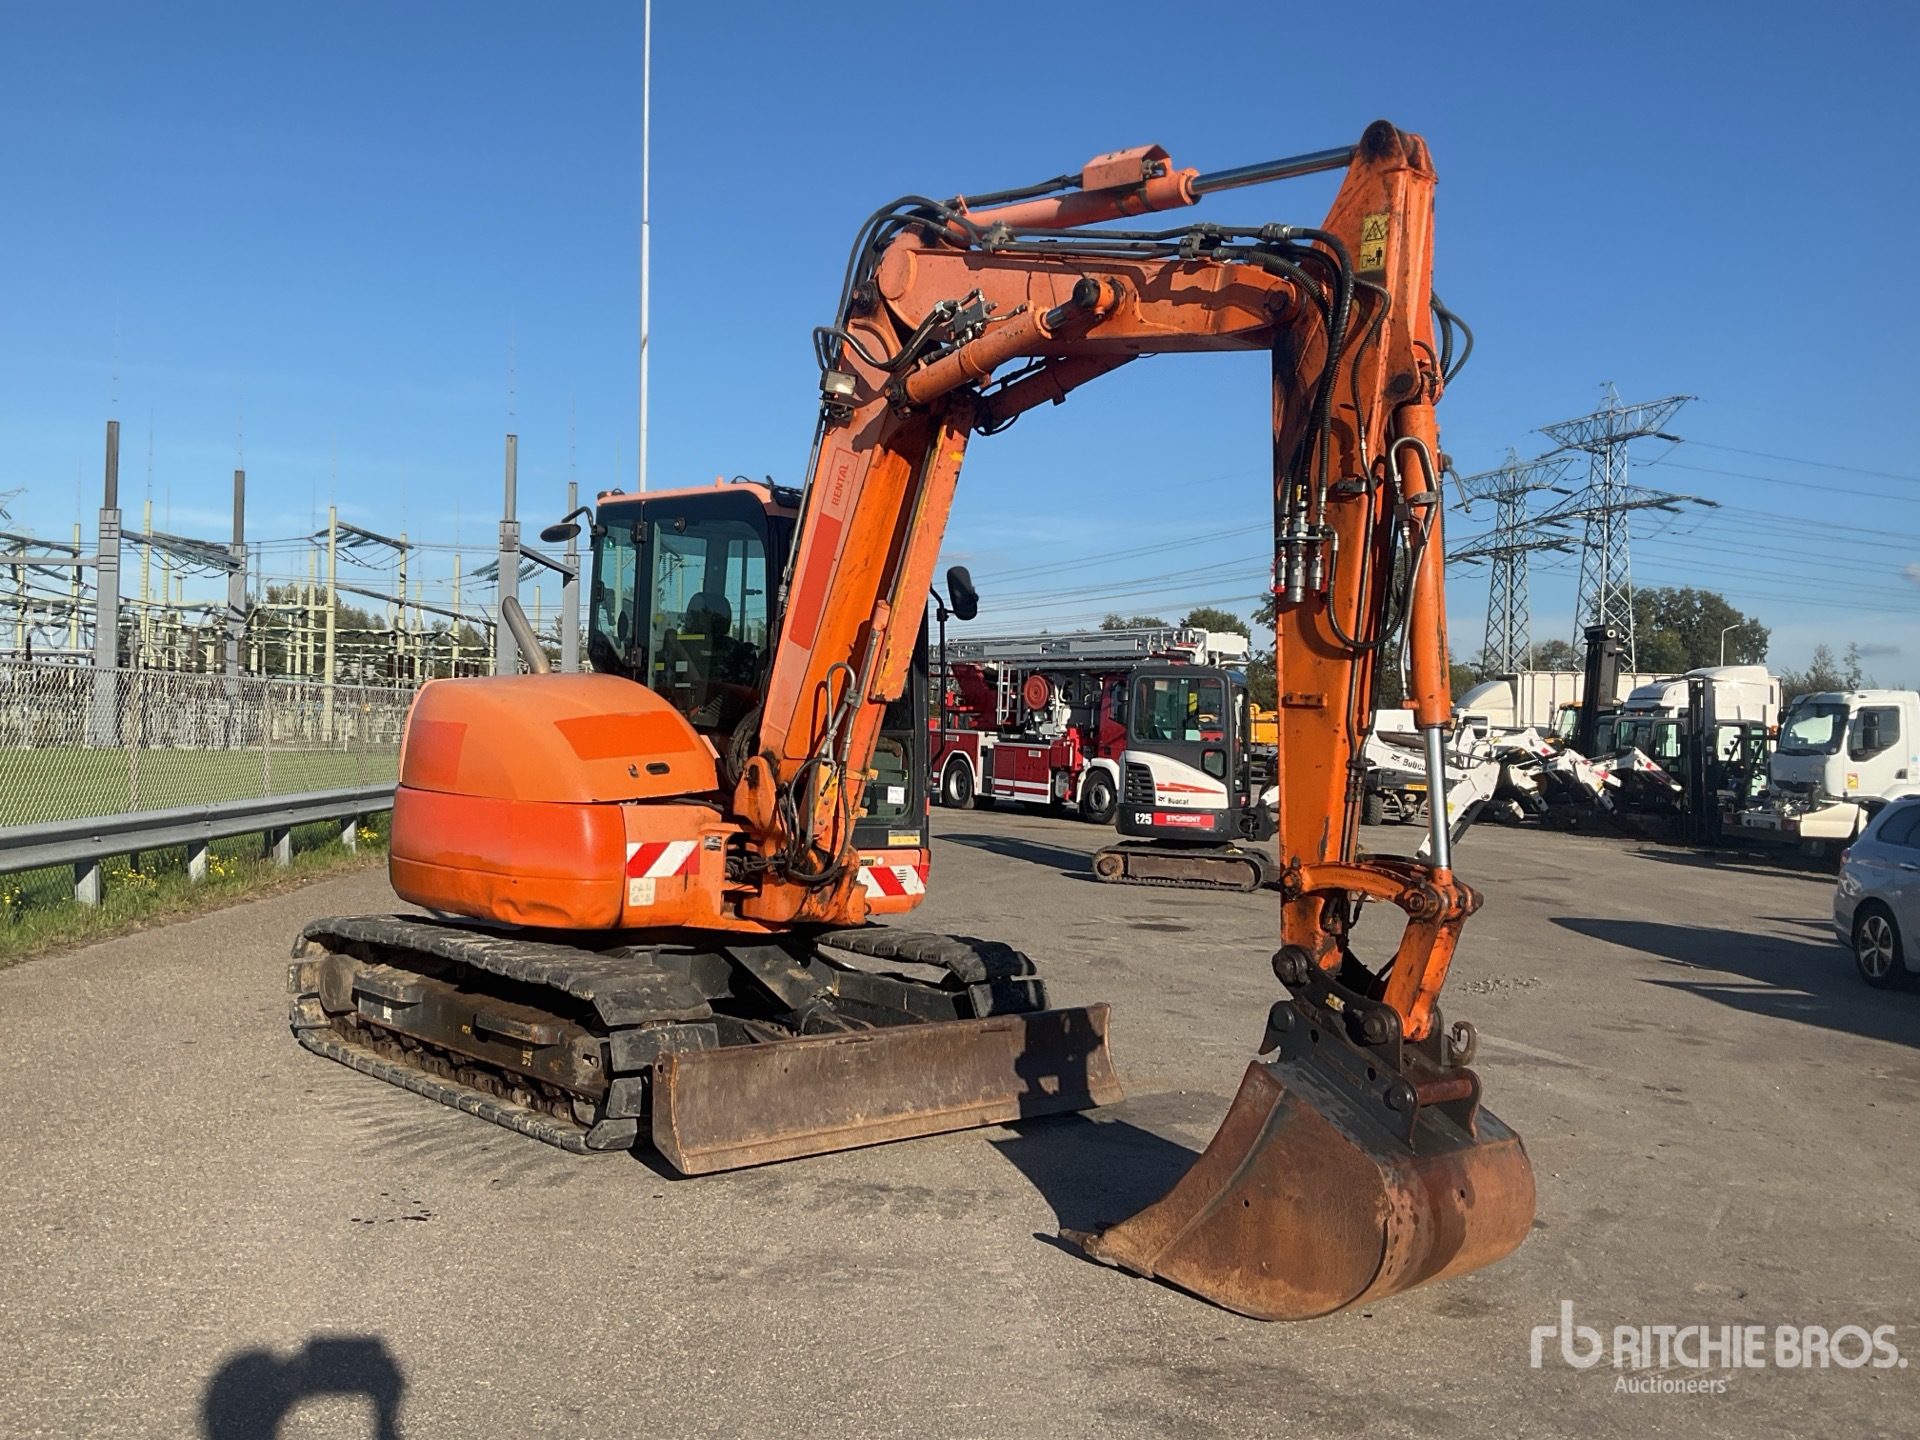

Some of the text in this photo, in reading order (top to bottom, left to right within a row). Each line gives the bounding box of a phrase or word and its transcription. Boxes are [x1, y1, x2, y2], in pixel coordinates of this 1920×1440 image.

[832, 464, 849, 506] RENTAL
[1135, 812, 1152, 825] E25
[1166, 814, 1201, 823] STORENT
